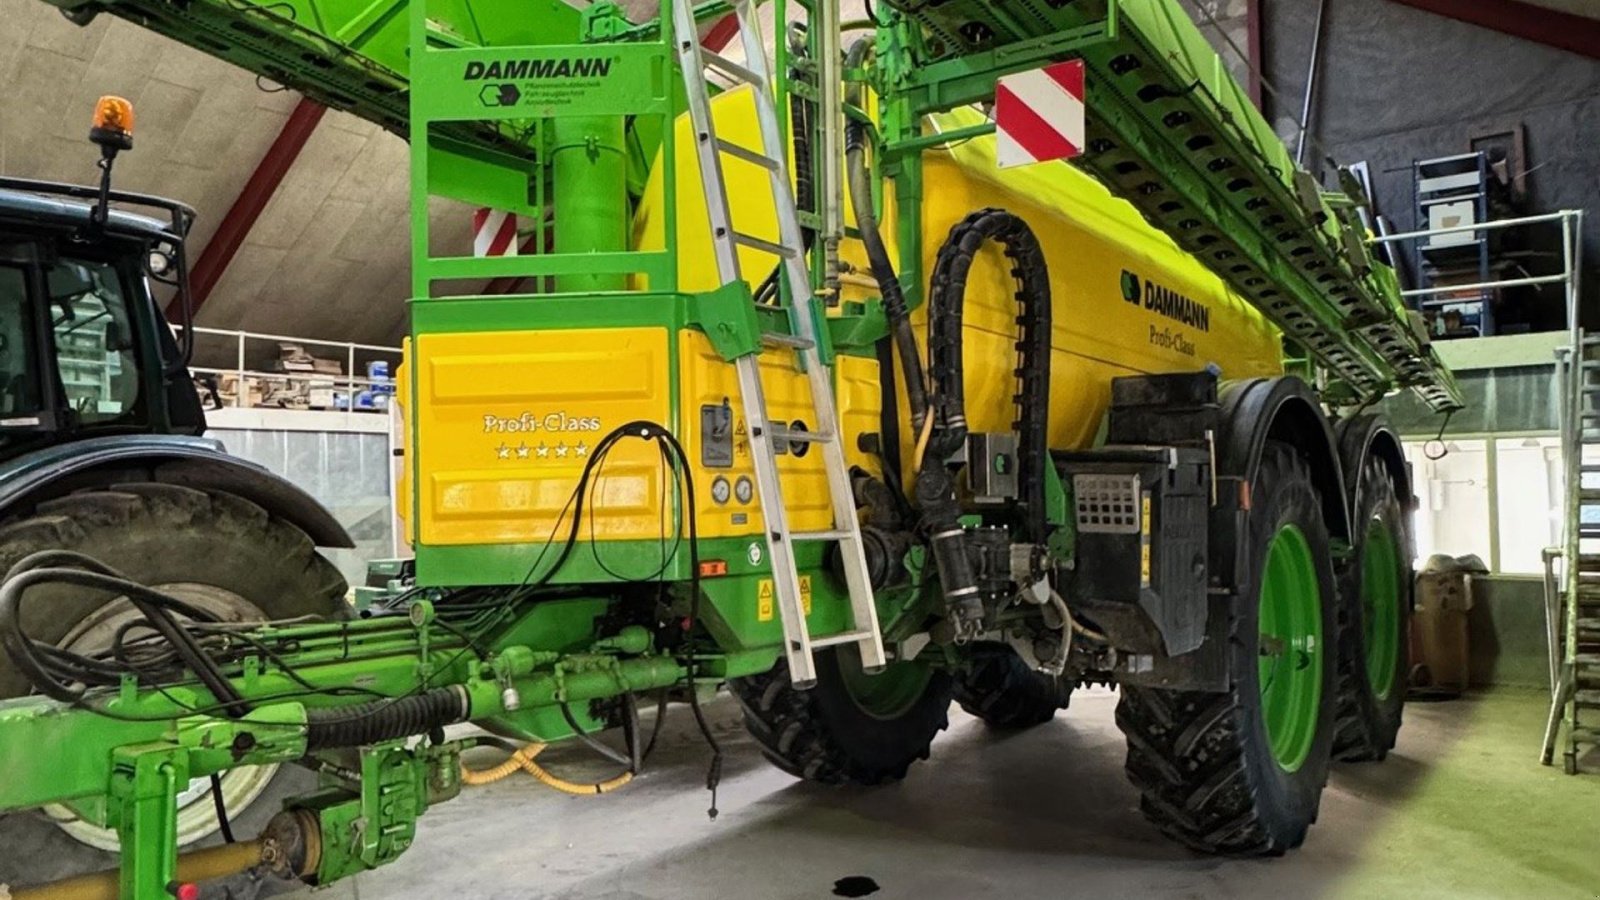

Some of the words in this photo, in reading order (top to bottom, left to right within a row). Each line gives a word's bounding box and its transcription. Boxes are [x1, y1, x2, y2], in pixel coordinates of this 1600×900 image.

[463, 57, 612, 80] DAMMANN
[1145, 279, 1209, 333] DAMMANN
[1149, 324, 1195, 357] Profi-Class
[483, 411, 601, 433] Profi-Class
